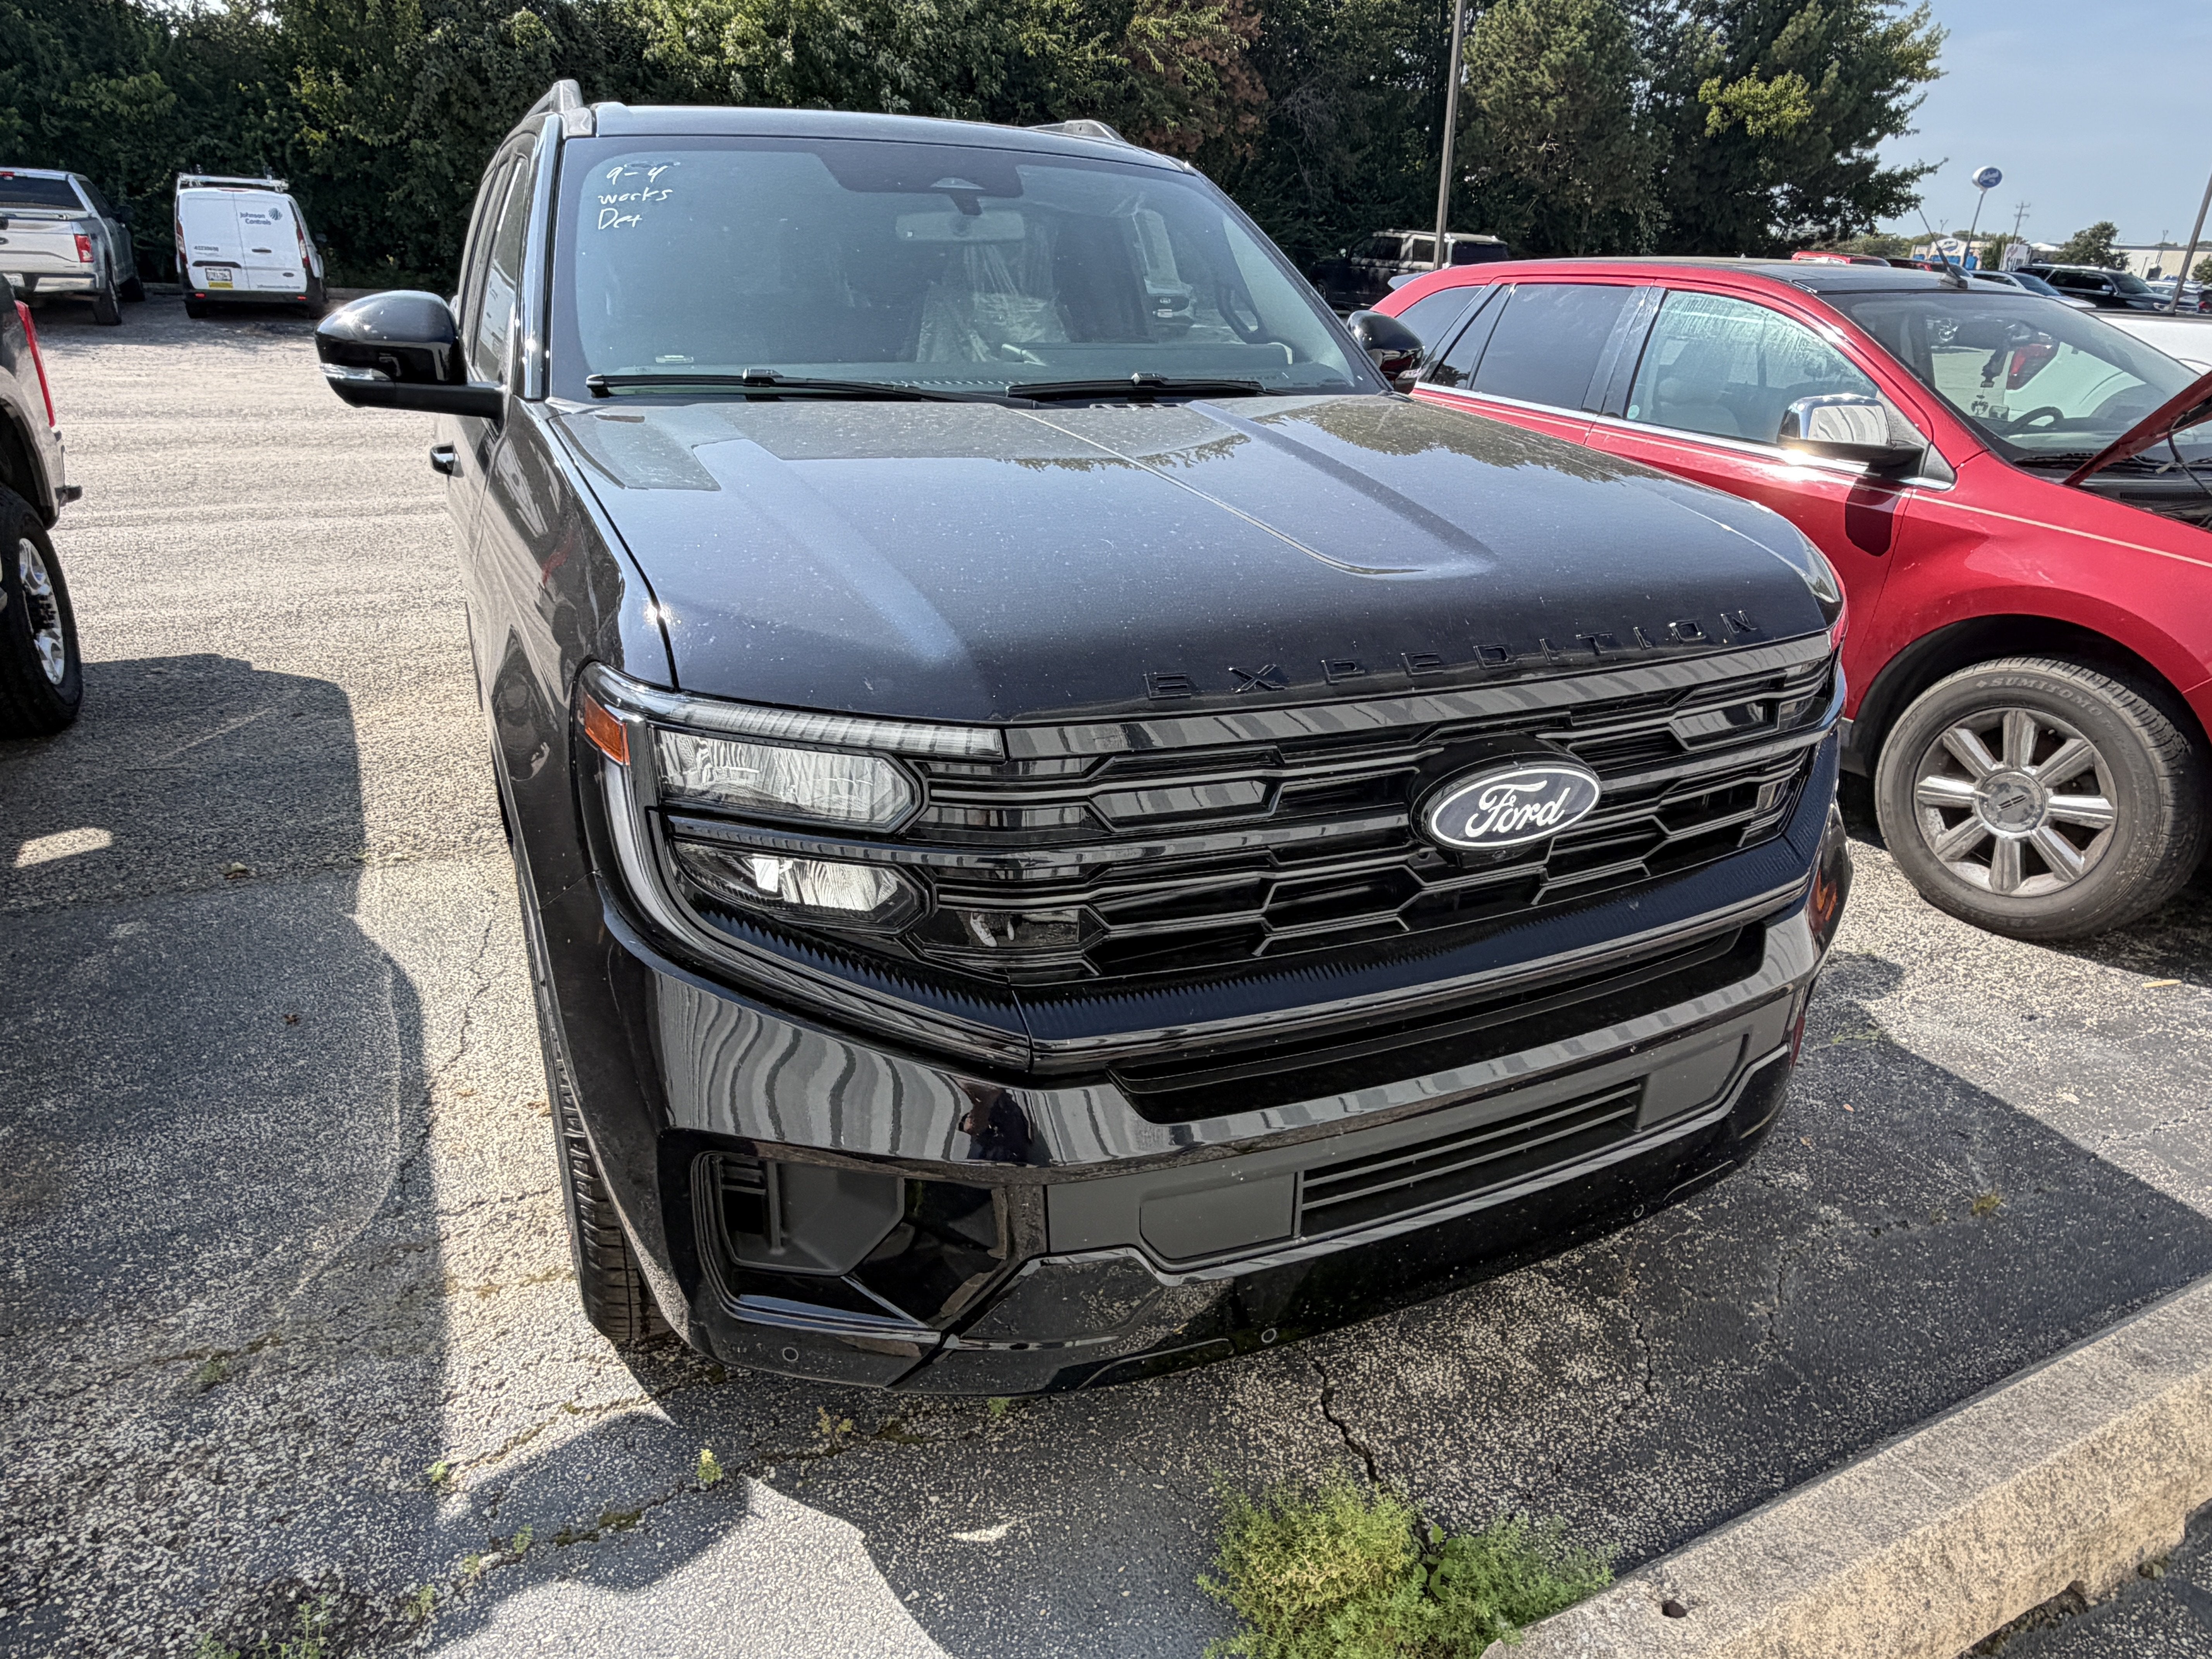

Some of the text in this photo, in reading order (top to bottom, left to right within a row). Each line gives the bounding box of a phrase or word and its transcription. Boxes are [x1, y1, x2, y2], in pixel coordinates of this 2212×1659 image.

[598, 187, 673, 204] works
[1142, 610, 1758, 701] EXPEDITION
[1990, 676, 2102, 716] SUMITOMO
[1465, 780, 1571, 837] Ford
